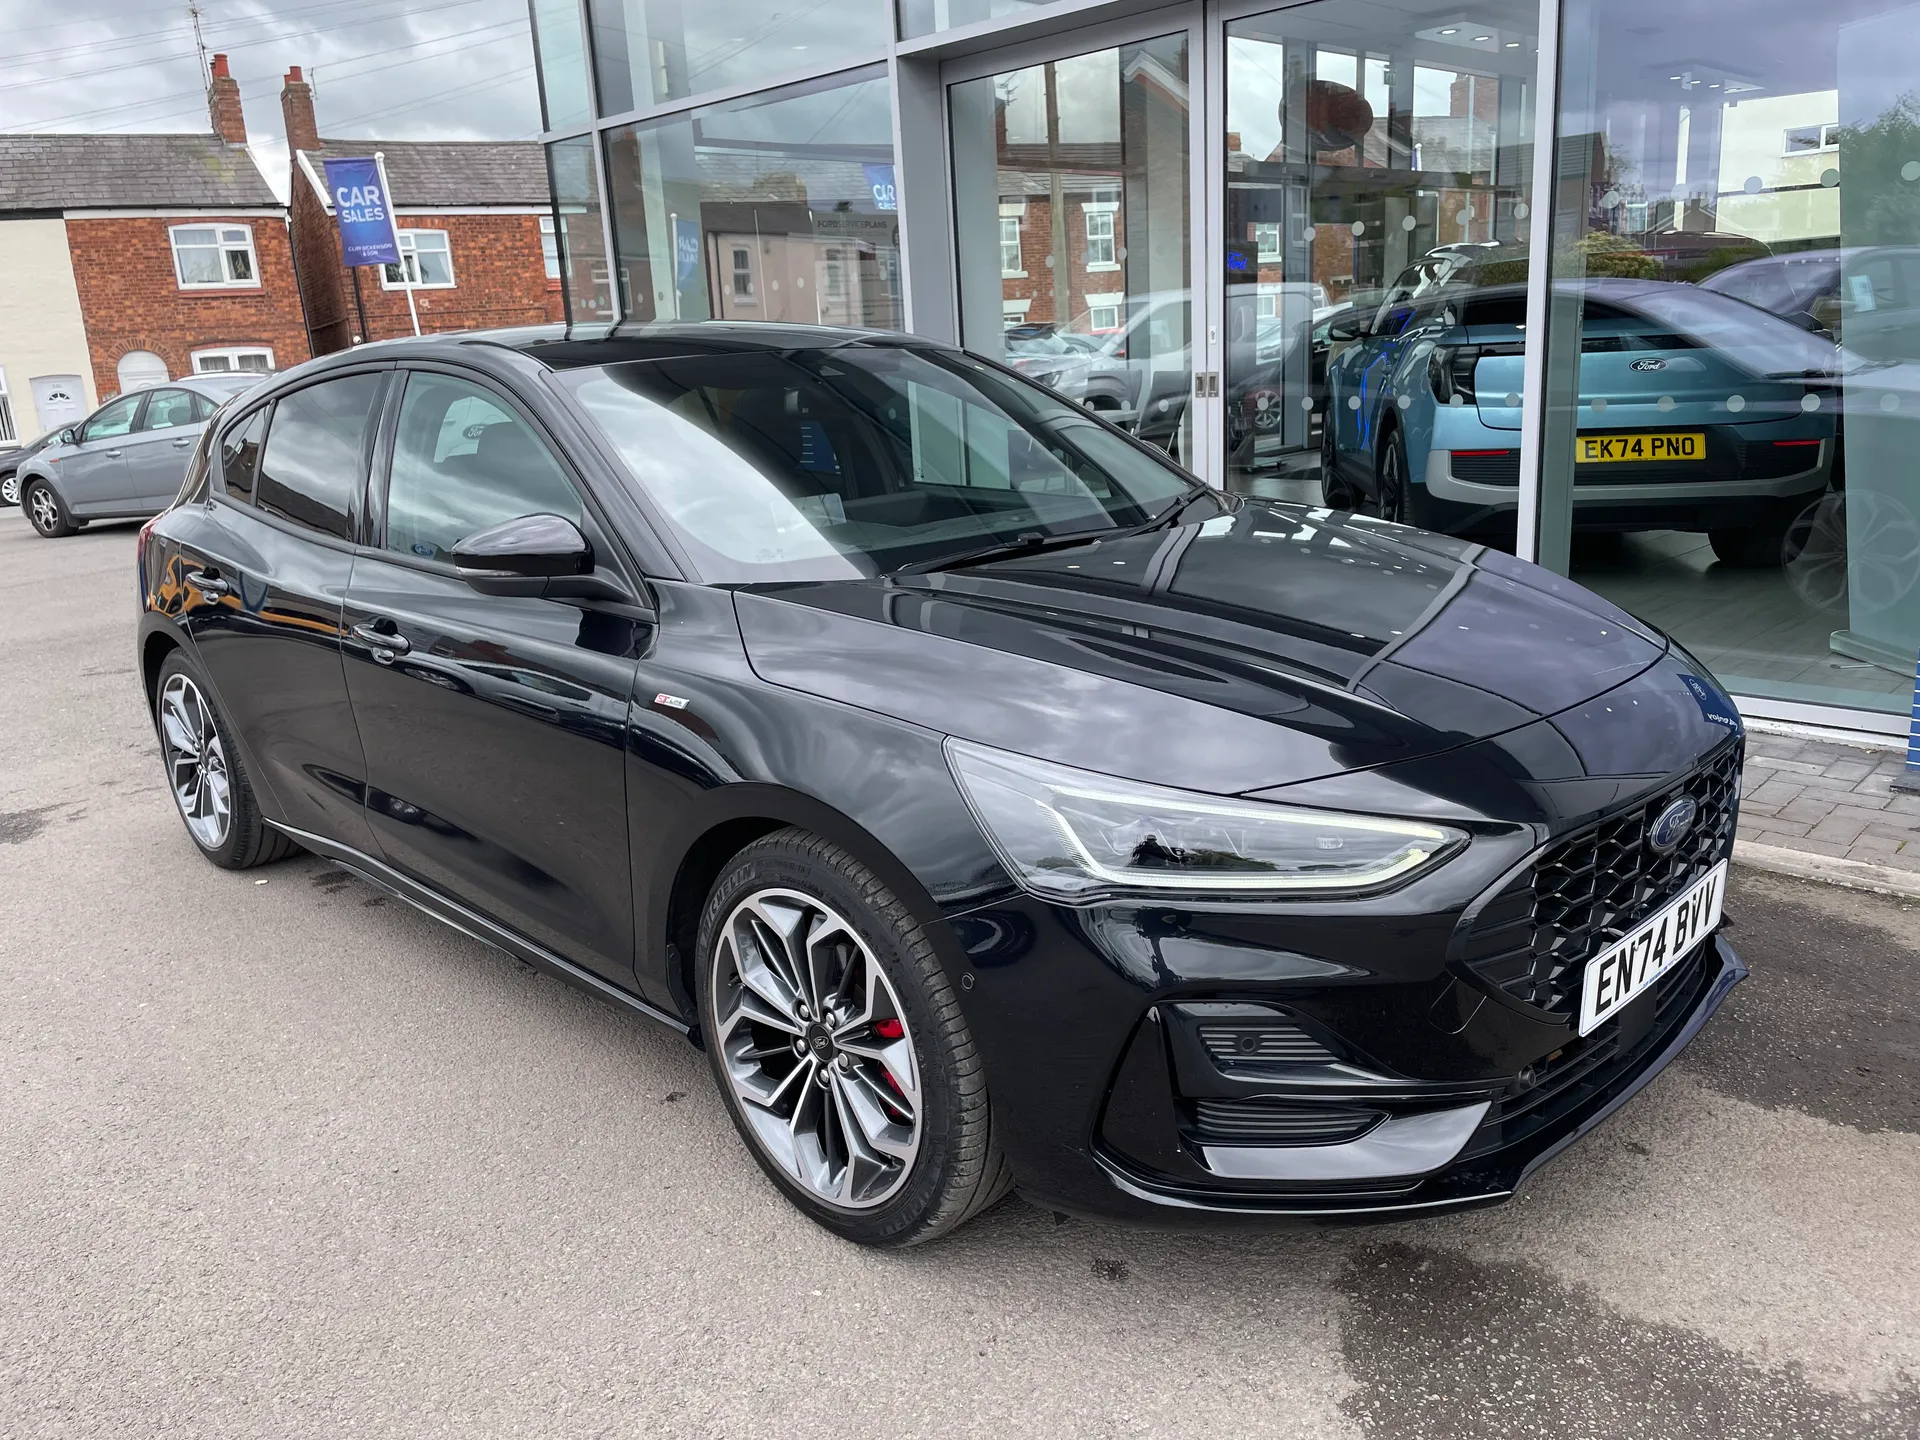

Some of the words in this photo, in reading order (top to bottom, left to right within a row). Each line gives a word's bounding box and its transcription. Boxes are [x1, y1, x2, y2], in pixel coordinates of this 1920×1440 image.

[336, 185, 381, 207] CAR
[342, 208, 385, 223] SALES
[1637, 360, 1661, 370] Ford
[467, 425, 484, 438] For
[1585, 438, 1644, 459] EK74
[1651, 437, 1695, 456] PNO
[702, 863, 753, 938] MICHELIN
[1595, 916, 1668, 1016] EN74
[1673, 875, 1718, 956] BVV
